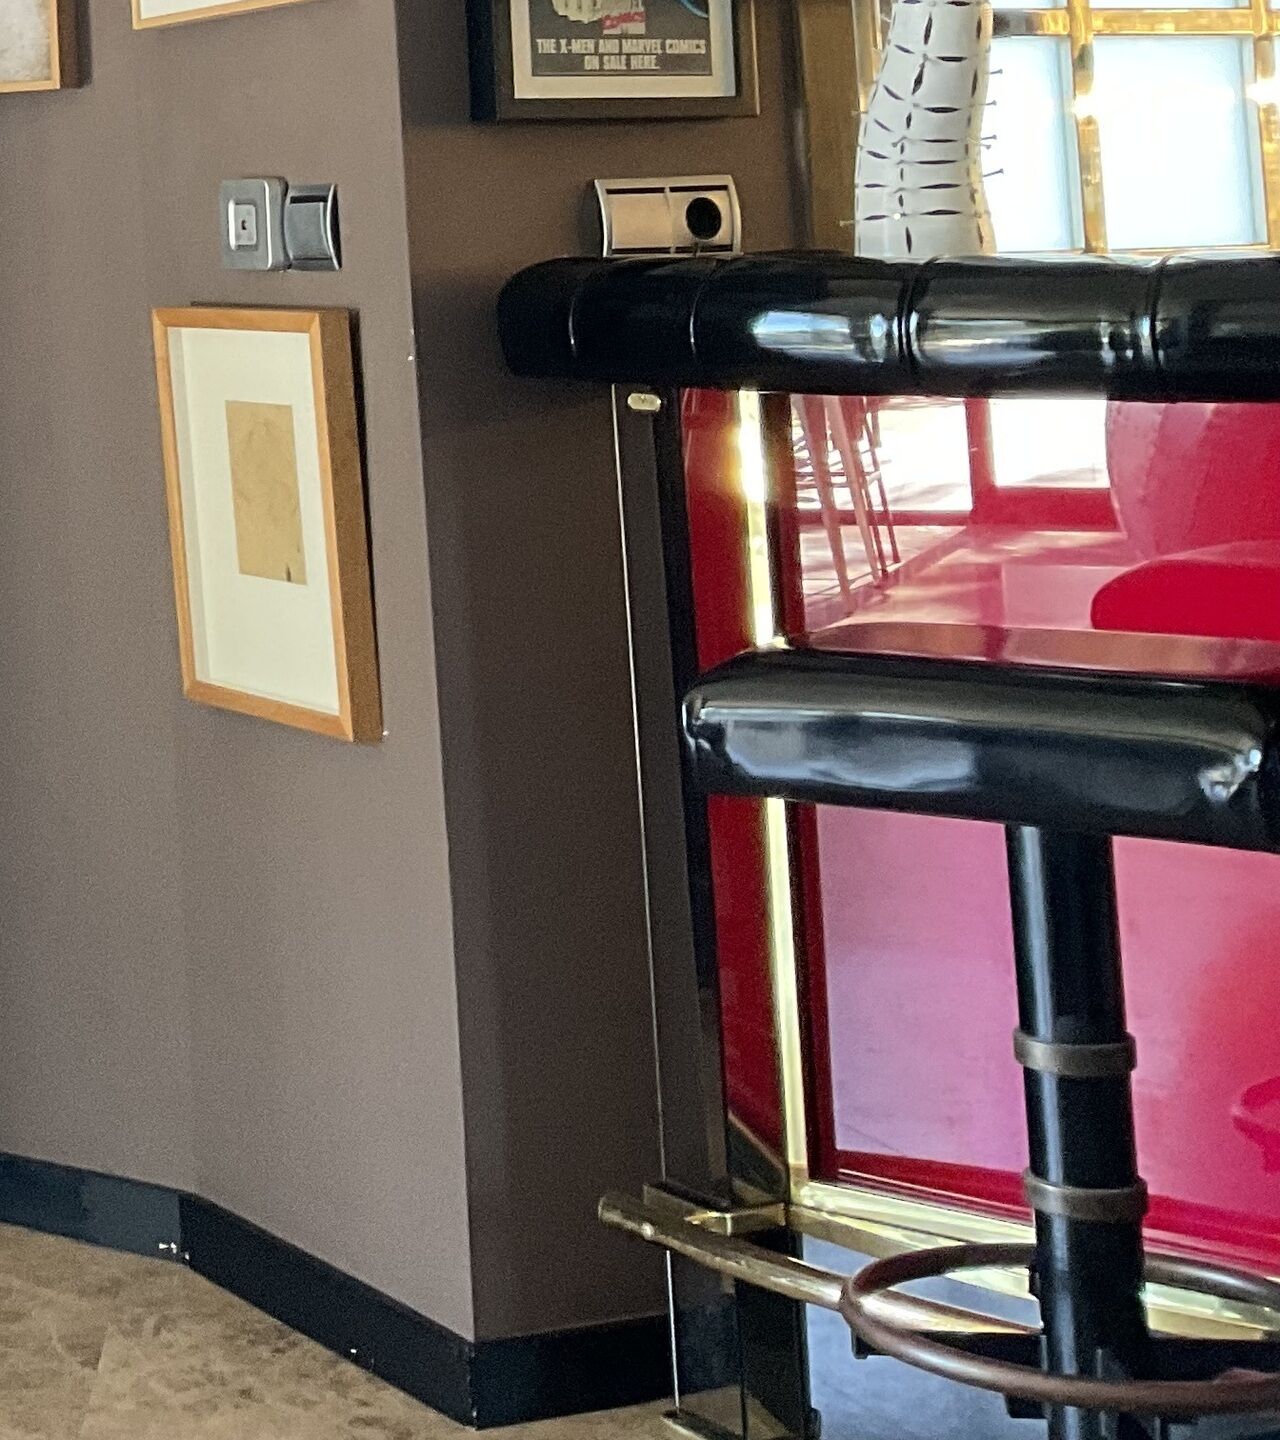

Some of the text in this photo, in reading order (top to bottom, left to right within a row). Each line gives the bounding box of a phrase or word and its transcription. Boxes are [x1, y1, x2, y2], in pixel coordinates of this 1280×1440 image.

[536, 38, 707, 55] THE X-MEN AND MARVEL COMICS
[584, 54, 600, 71] ON
[603, 54, 628, 70] SALE
